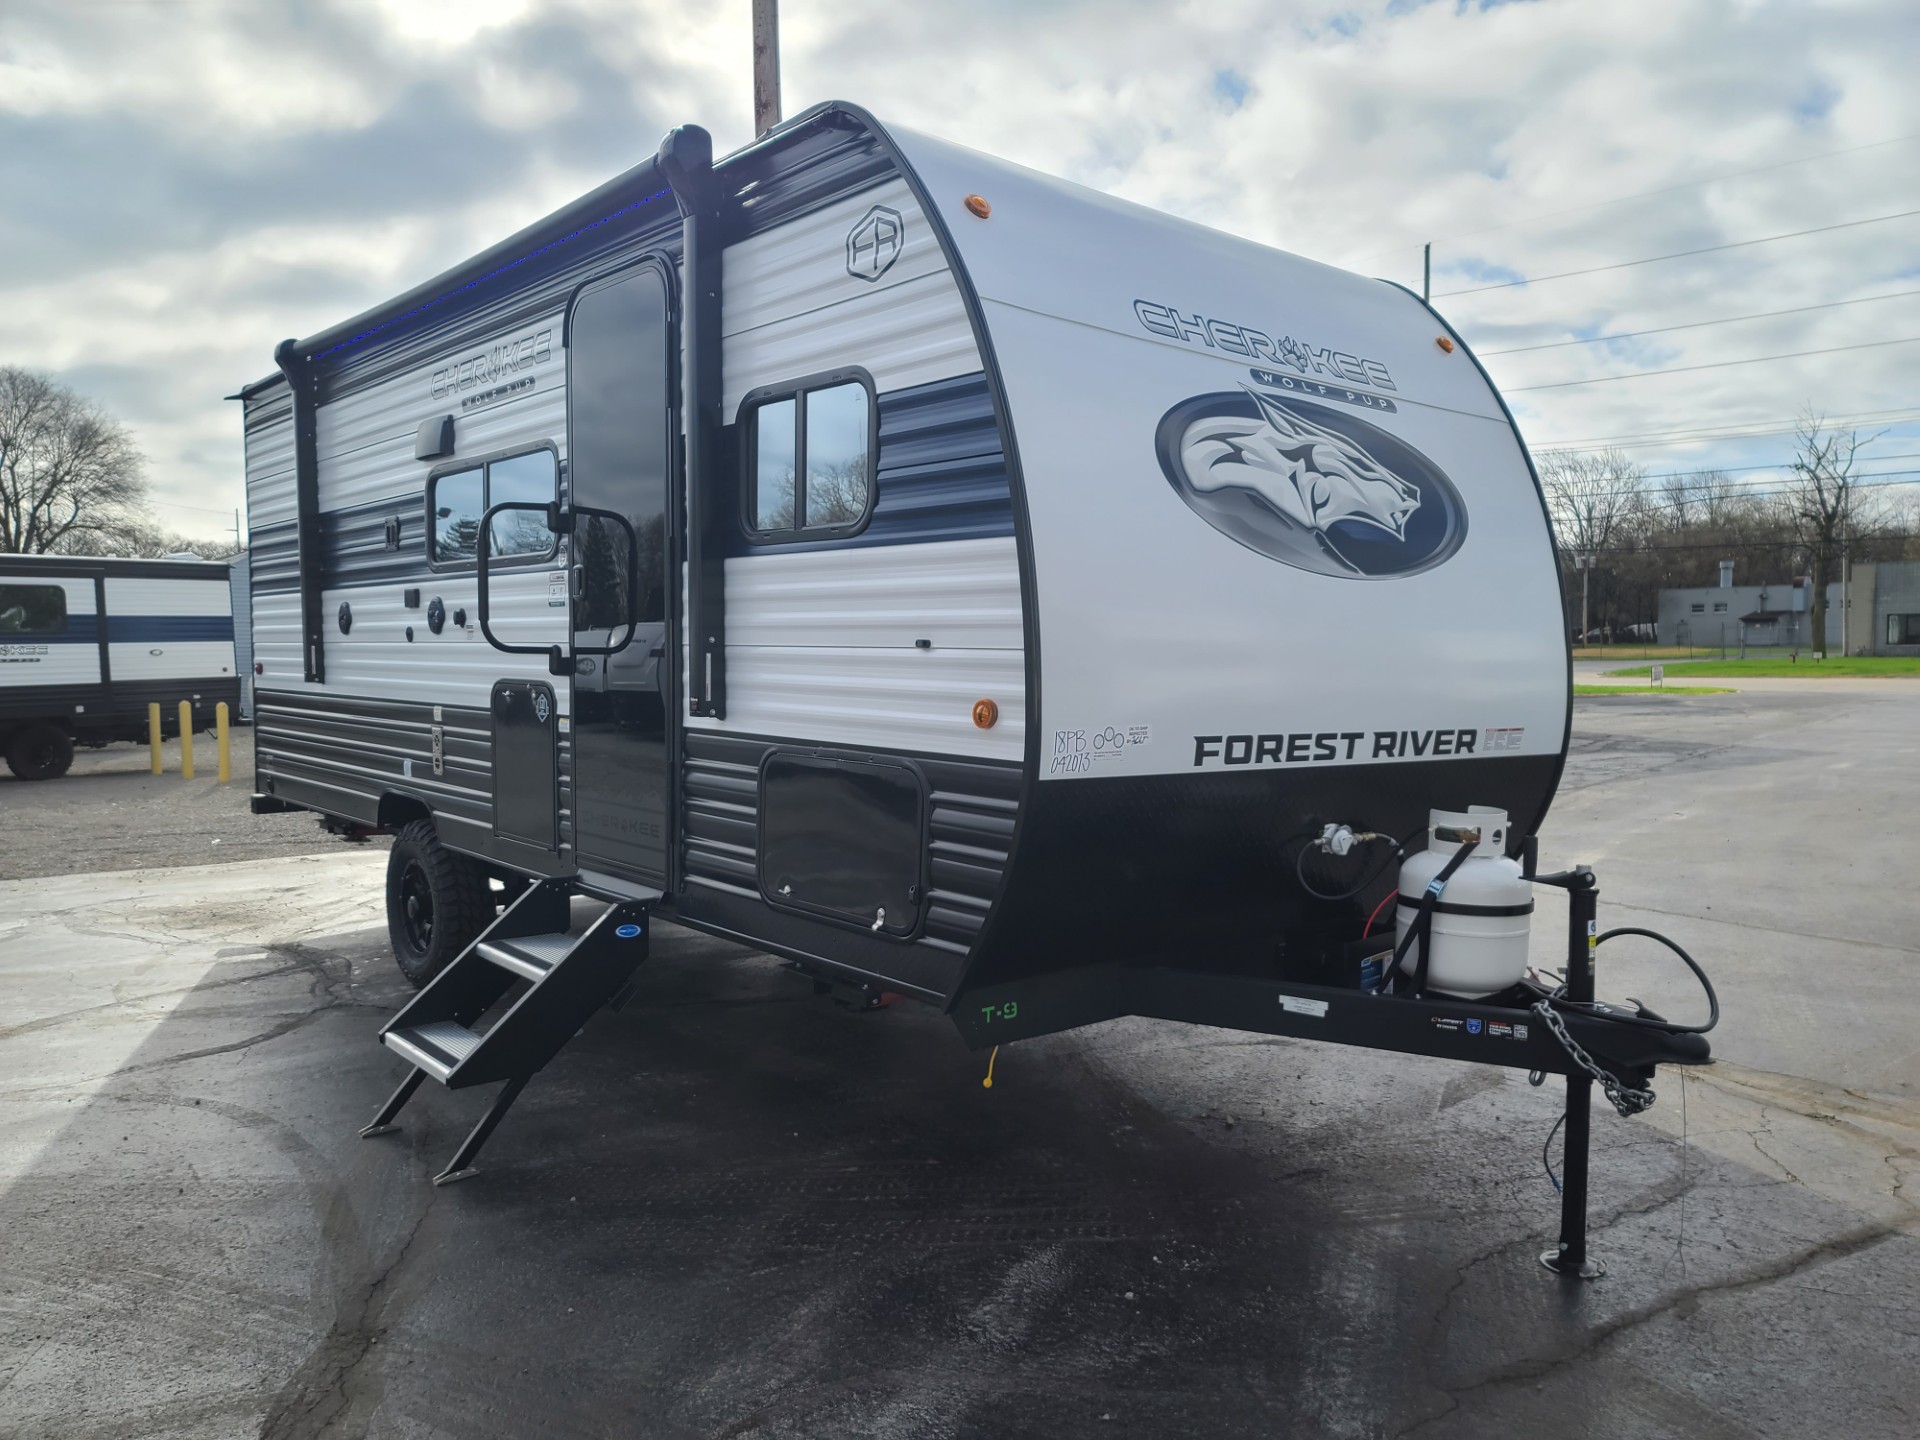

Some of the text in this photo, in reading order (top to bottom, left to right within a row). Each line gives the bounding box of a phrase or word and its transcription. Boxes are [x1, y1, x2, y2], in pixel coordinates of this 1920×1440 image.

[431, 328, 552, 400] CHEROKEE
[1133, 299, 1397, 391] CHEROKEE
[464, 379, 532, 408] WOLF PUP
[1258, 371, 1389, 409] WOLF PUP
[1053, 729, 1087, 756] 18PB
[1193, 731, 1365, 767] FOREST
[1372, 728, 1478, 758] RIVER
